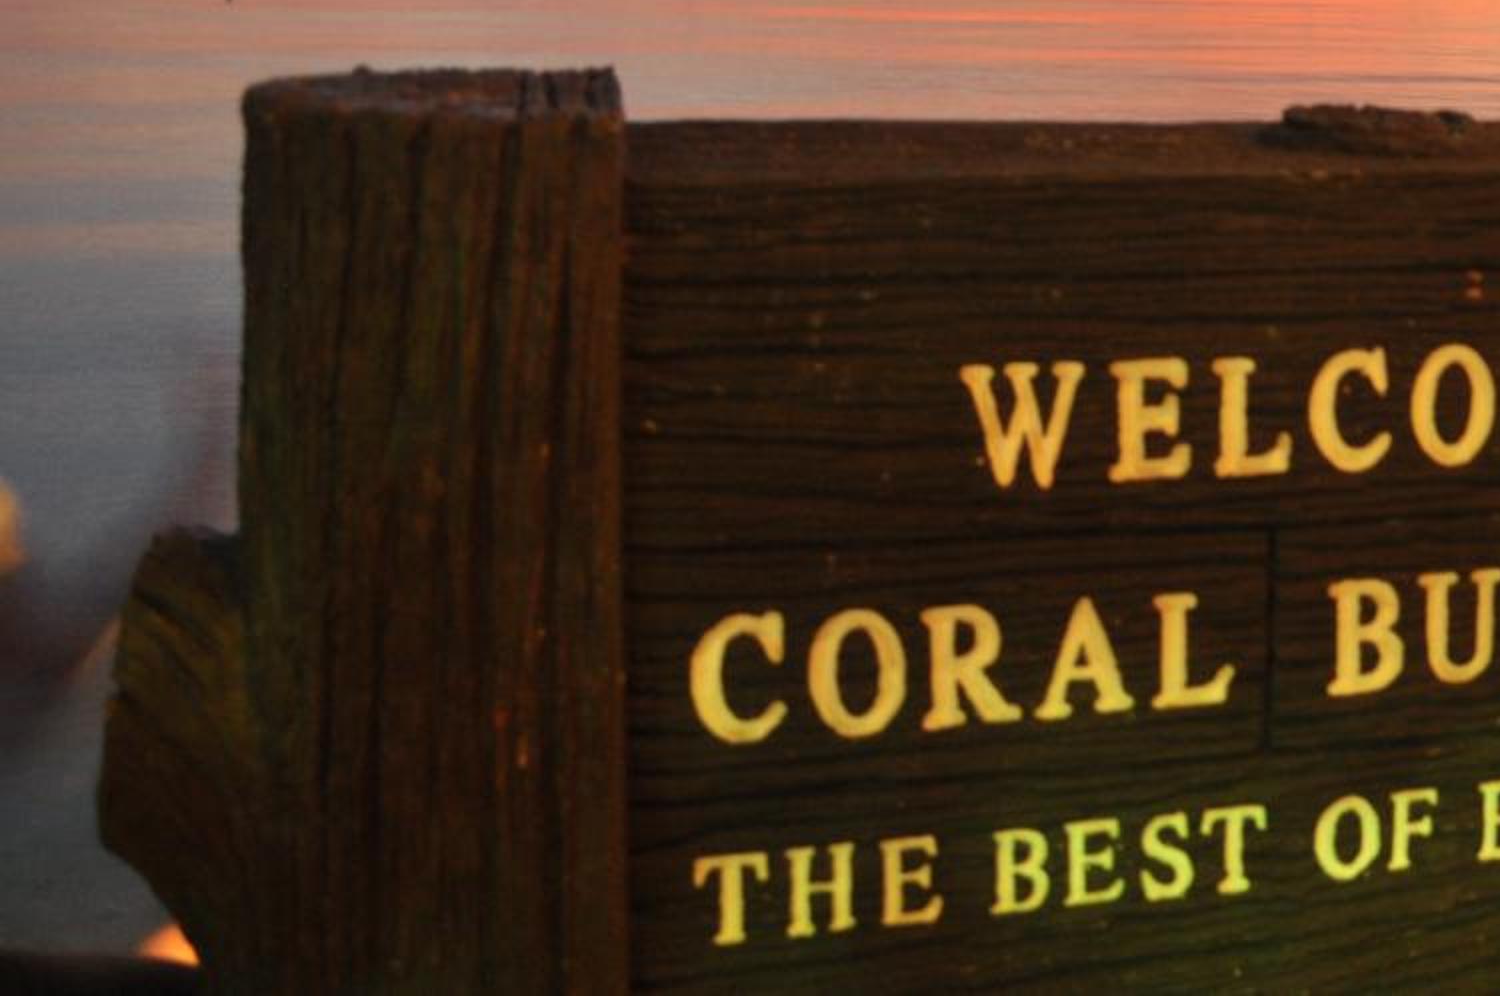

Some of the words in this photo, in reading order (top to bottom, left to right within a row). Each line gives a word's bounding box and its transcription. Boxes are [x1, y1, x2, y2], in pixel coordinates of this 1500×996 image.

[689, 592, 1236, 744] CORAL
[693, 835, 945, 945] THE
[989, 804, 1267, 915] BEST
[1313, 787, 1438, 881] OF
